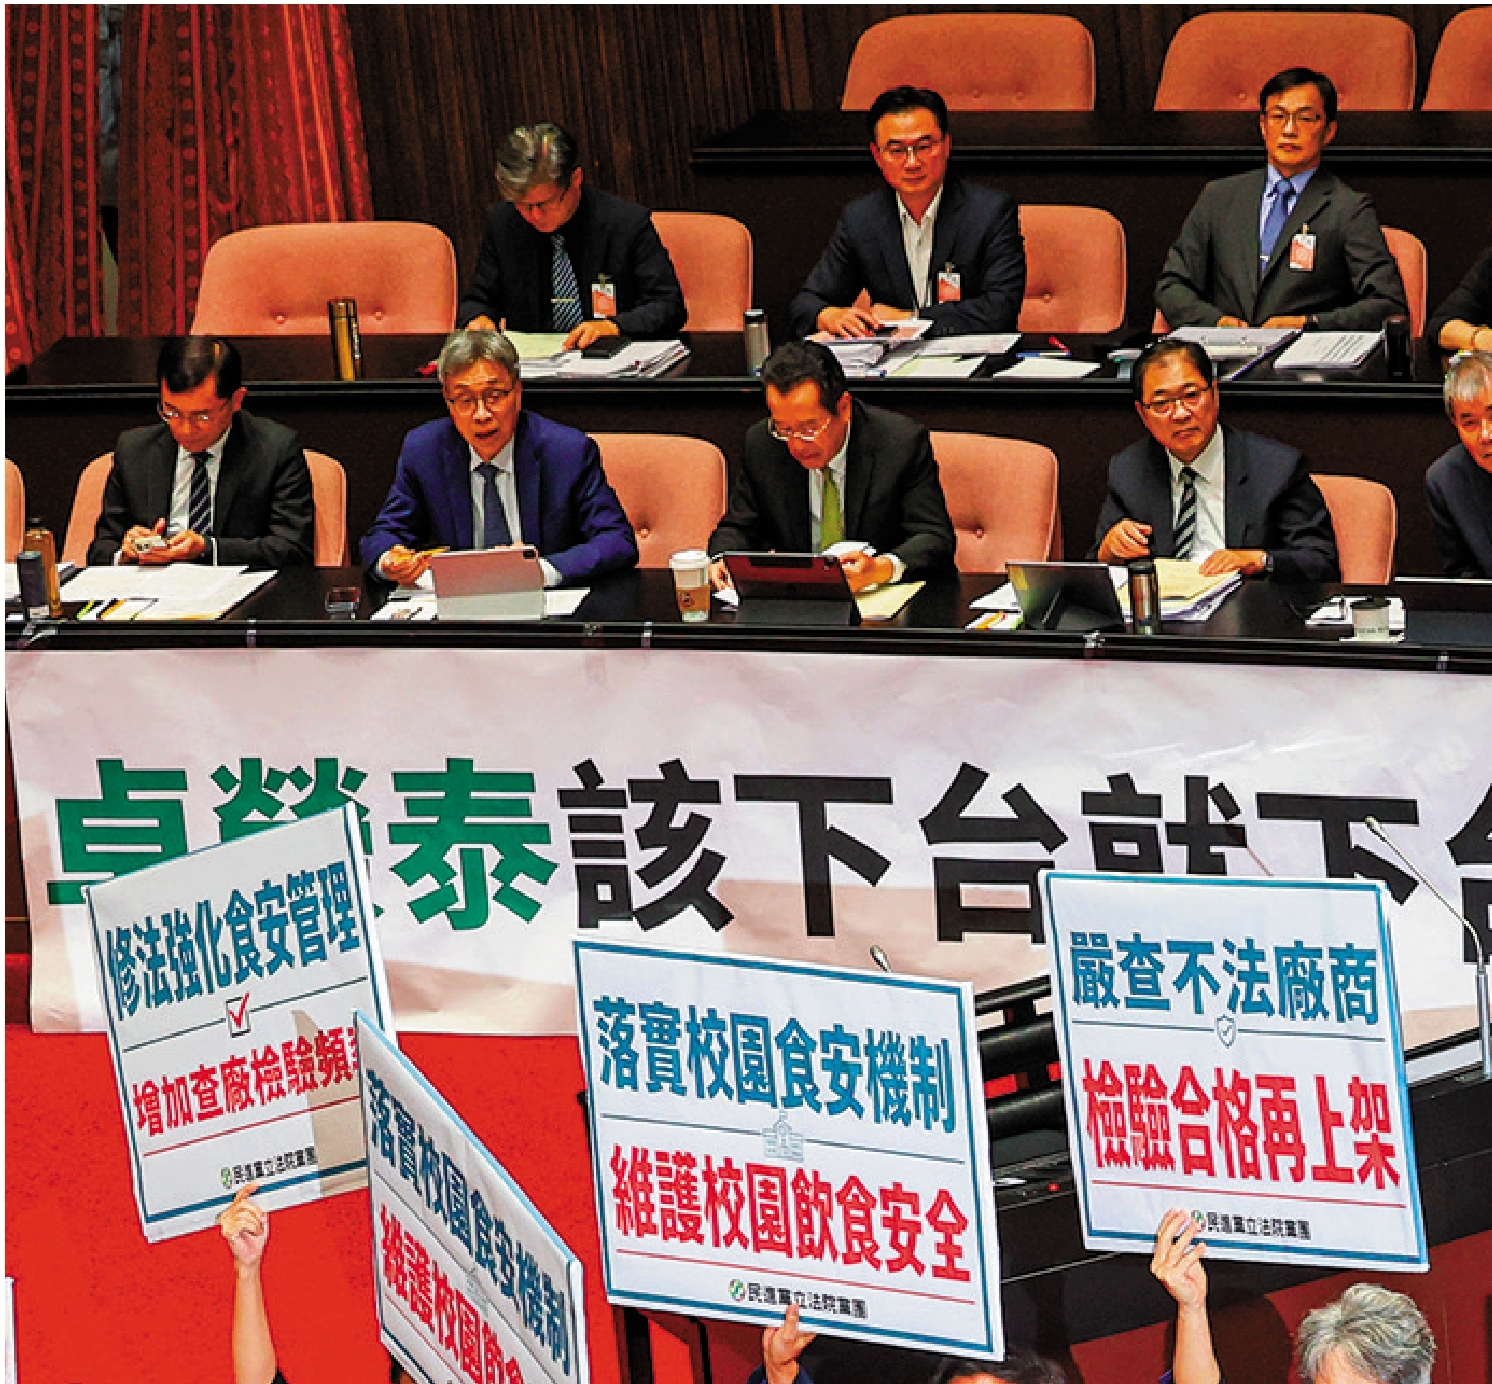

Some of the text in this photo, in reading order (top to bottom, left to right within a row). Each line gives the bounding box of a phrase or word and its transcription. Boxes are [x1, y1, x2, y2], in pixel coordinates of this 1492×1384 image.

[106, 861, 360, 1021] 修法強化食安管理
[1070, 931, 1379, 1025] 嚴查不法廠商
[594, 995, 956, 1133] 落實校園食安機制
[1082, 1058, 1401, 1190] 檢驗合格再上架
[367, 1069, 571, 1375] 落實校園食安機制
[611, 1143, 971, 1282] 維護校園飲食安全
